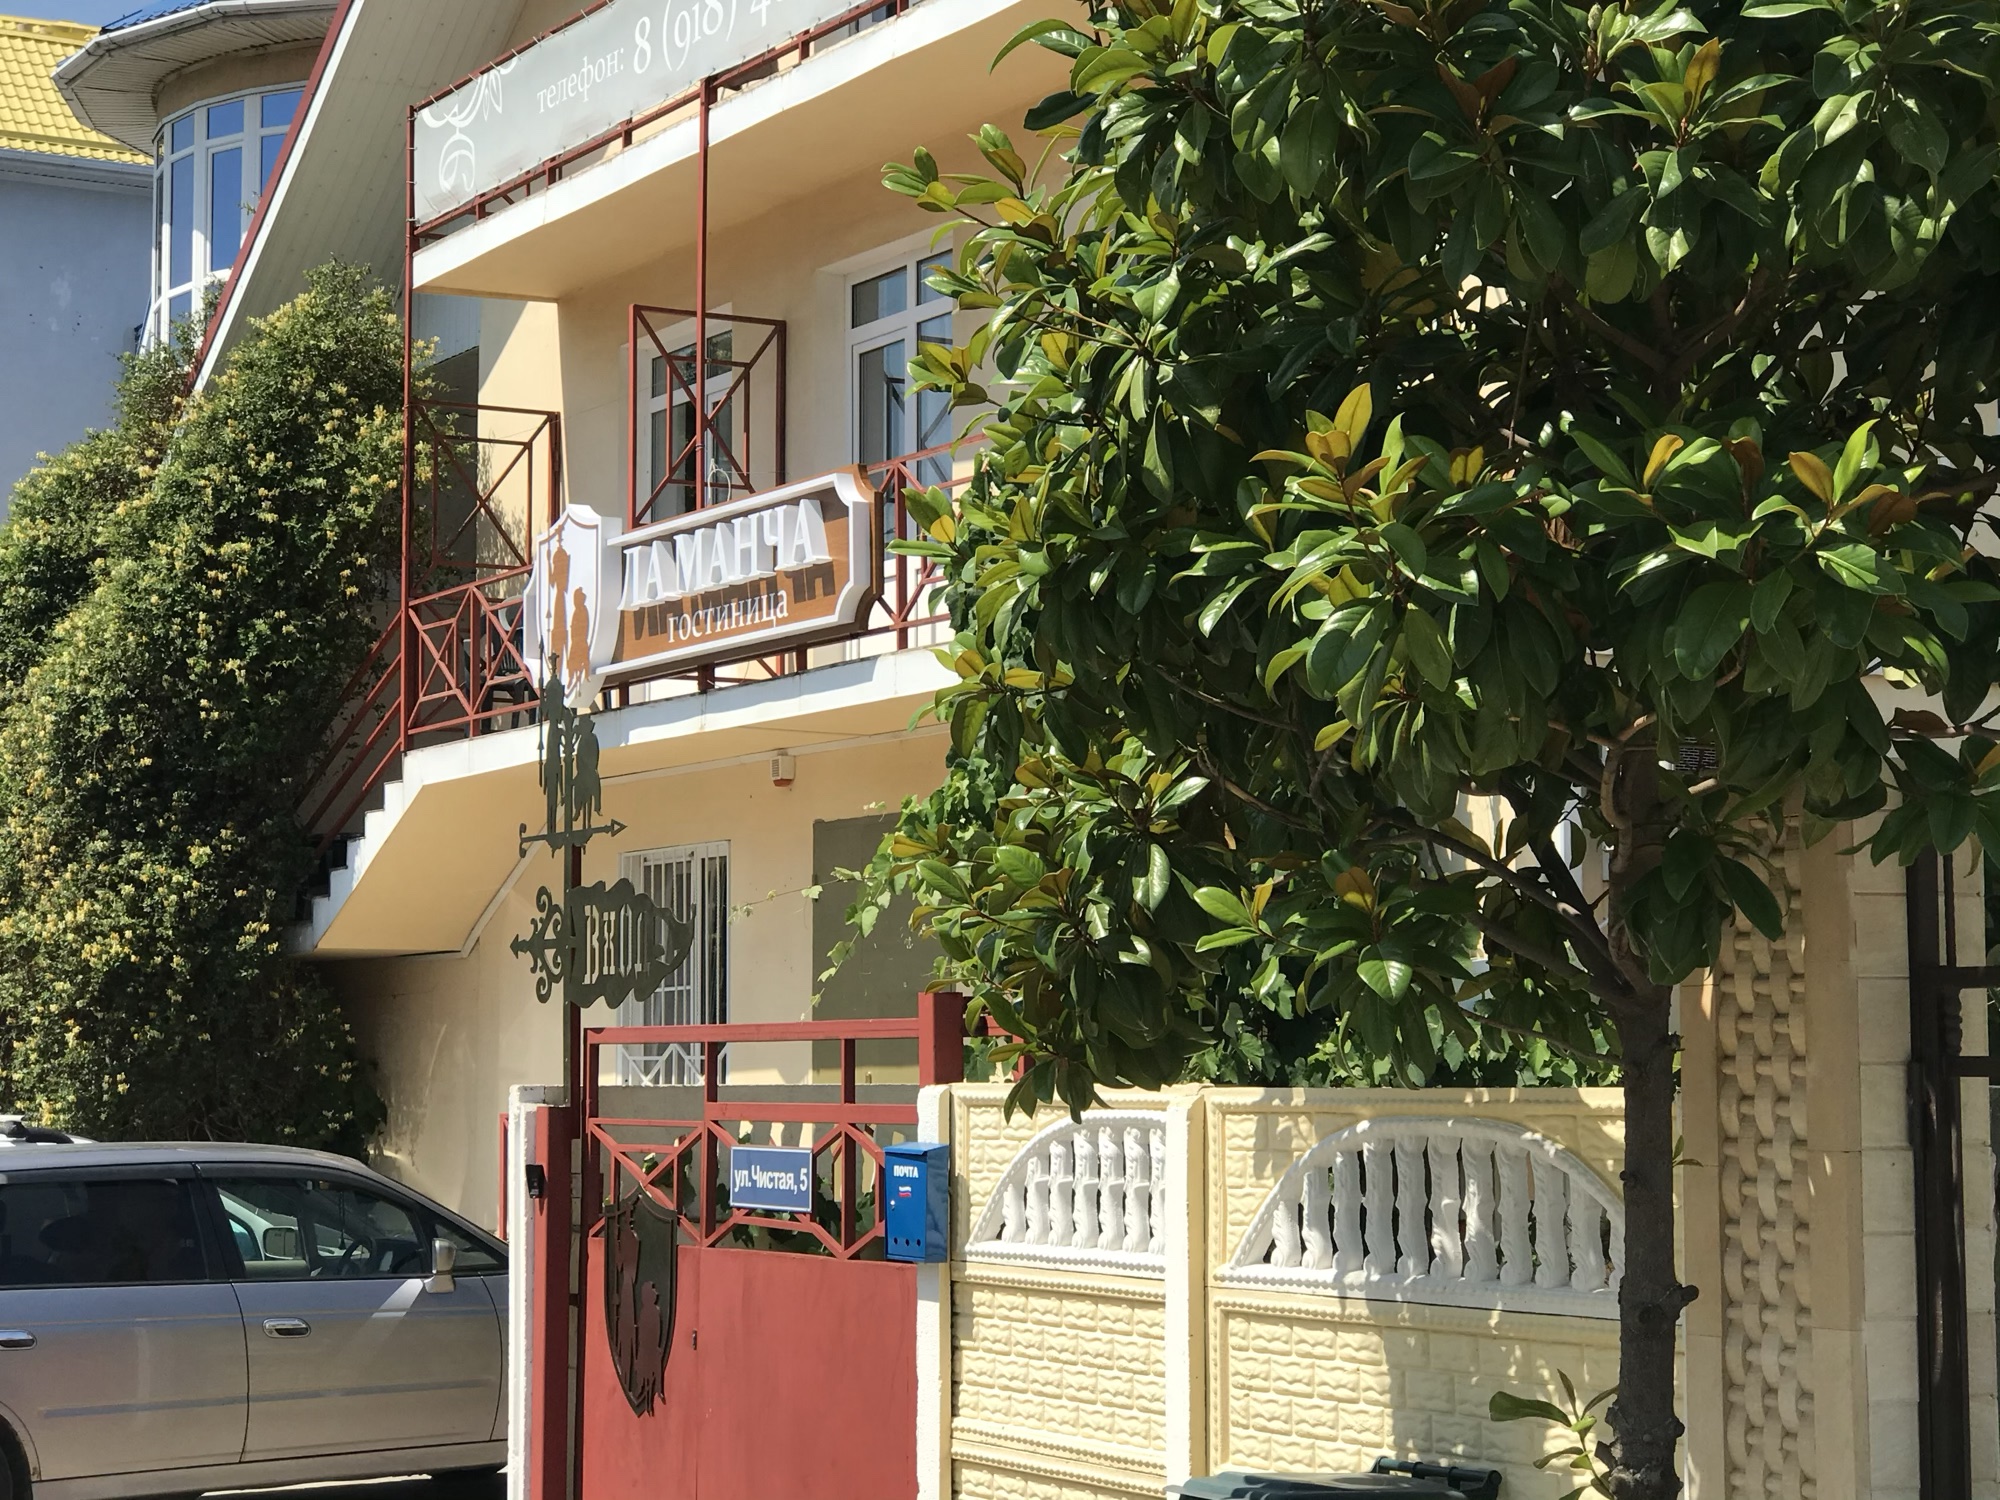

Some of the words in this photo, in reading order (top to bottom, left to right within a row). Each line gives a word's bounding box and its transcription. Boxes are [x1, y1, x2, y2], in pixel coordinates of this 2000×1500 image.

[536, 49, 624, 113] телефон:
[633, 16, 652, 74] 8
[618, 498, 832, 611] ЛАМАНЧА
[668, 589, 788, 643] гостиница
[799, 1168, 808, 1192] 5
[893, 1165, 919, 1178] ПОЧТА
